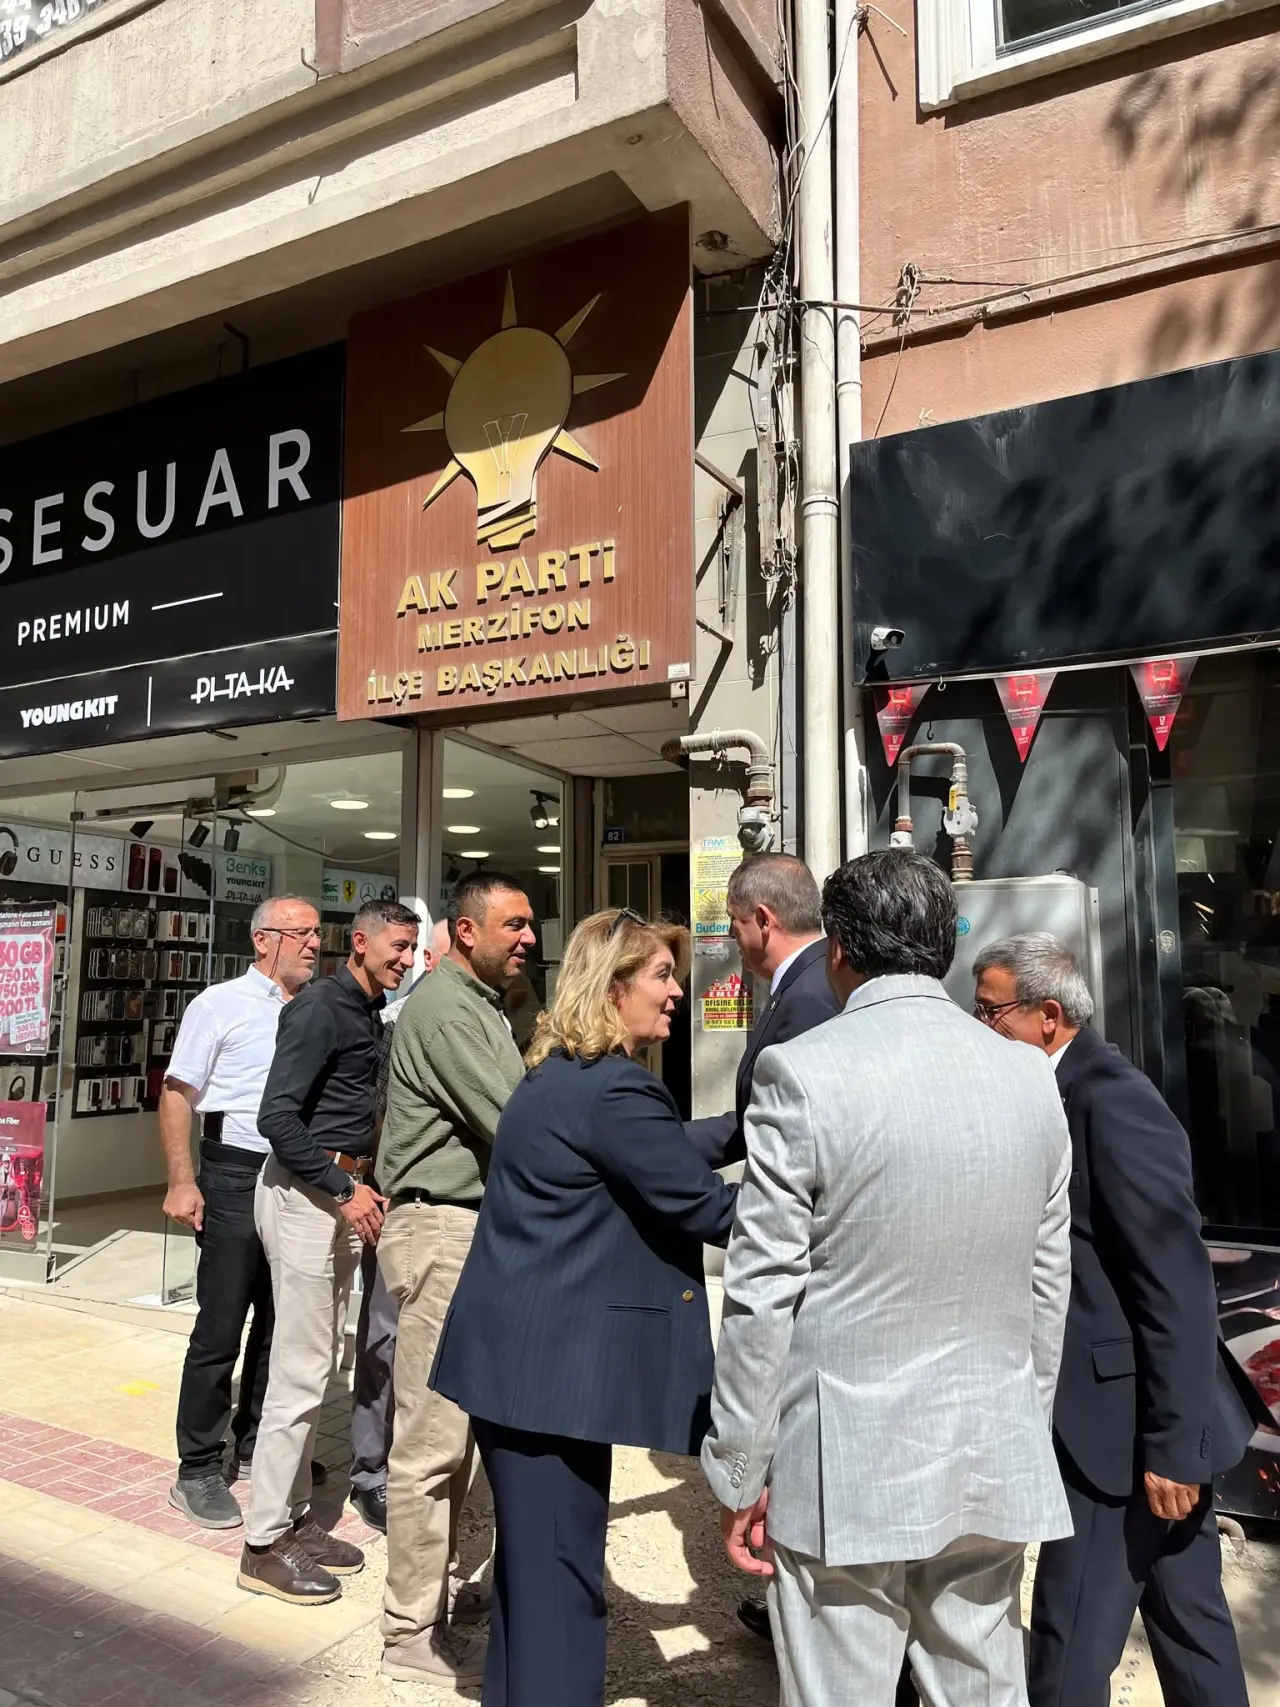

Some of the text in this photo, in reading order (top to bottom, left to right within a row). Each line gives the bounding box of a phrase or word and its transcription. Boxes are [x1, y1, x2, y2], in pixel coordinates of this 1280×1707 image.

[0, 15, 30, 59] 39
[397, 539, 616, 618] AK PARTİ
[17, 600, 130, 646] PREMIUM
[417, 598, 592, 653] MERZİFON
[367, 634, 651, 705] İLÇE BAŞKANLIĞI
[20, 695, 119, 728] YOUNGKIT
[27, 846, 115, 871] GUESS
[226, 857, 266, 877] Benks
[226, 877, 266, 889] YOUNGKIT
[20, 941, 43, 965] GB
[20, 981, 40, 996] SMS
[22, 967, 37, 981] DK
